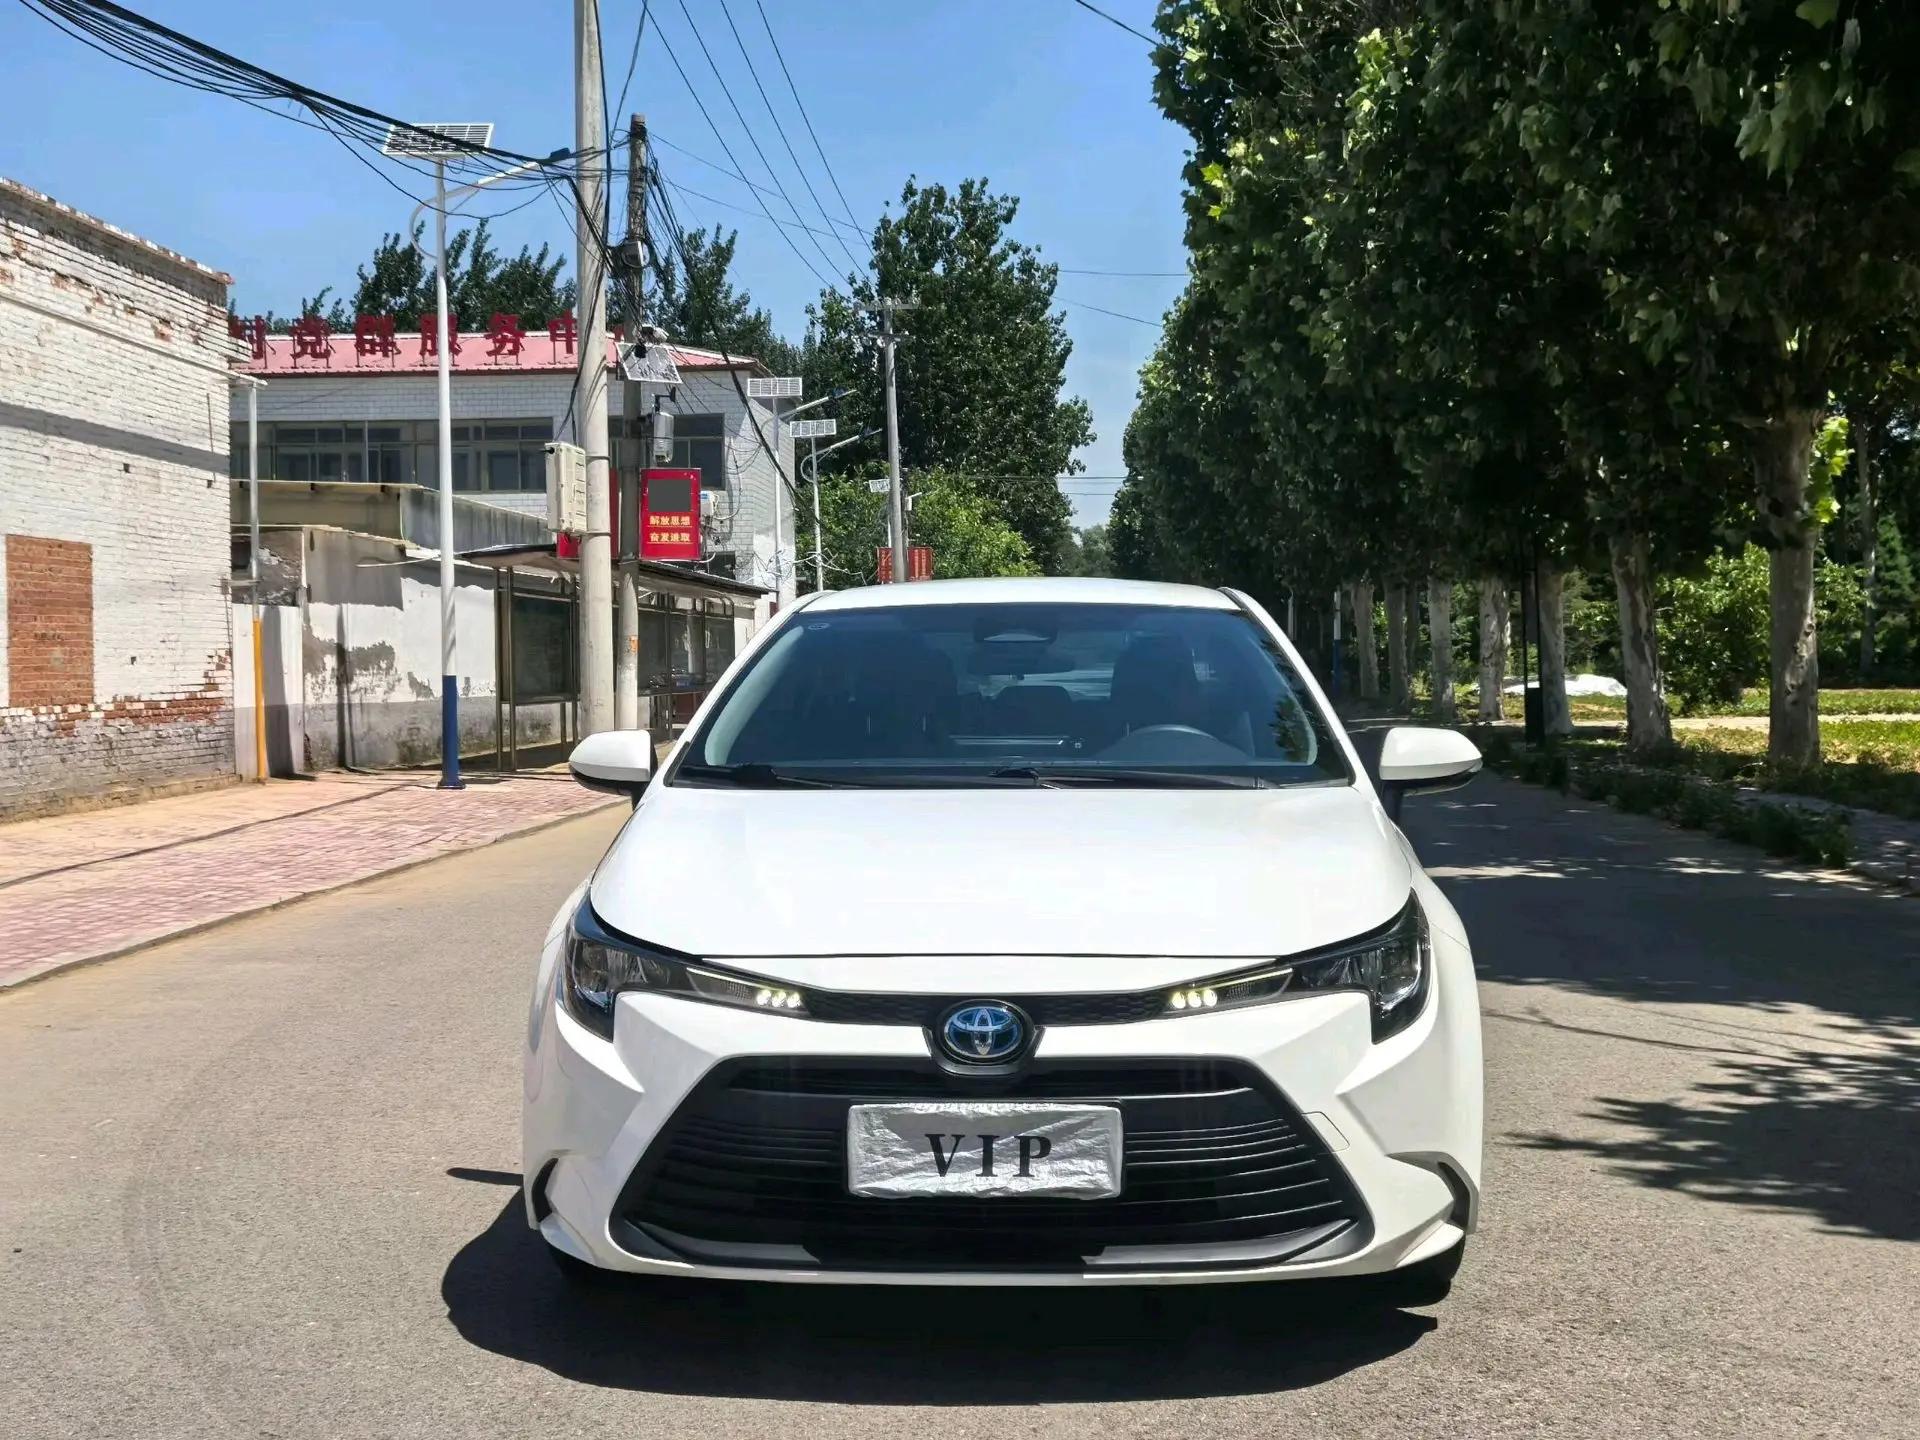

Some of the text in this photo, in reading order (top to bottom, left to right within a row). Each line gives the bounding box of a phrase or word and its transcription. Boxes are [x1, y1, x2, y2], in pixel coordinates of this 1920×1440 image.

[649, 515, 691, 526] 解放思想
[650, 532, 690, 542] 奋发进取
[924, 1133, 1052, 1178] VIP
